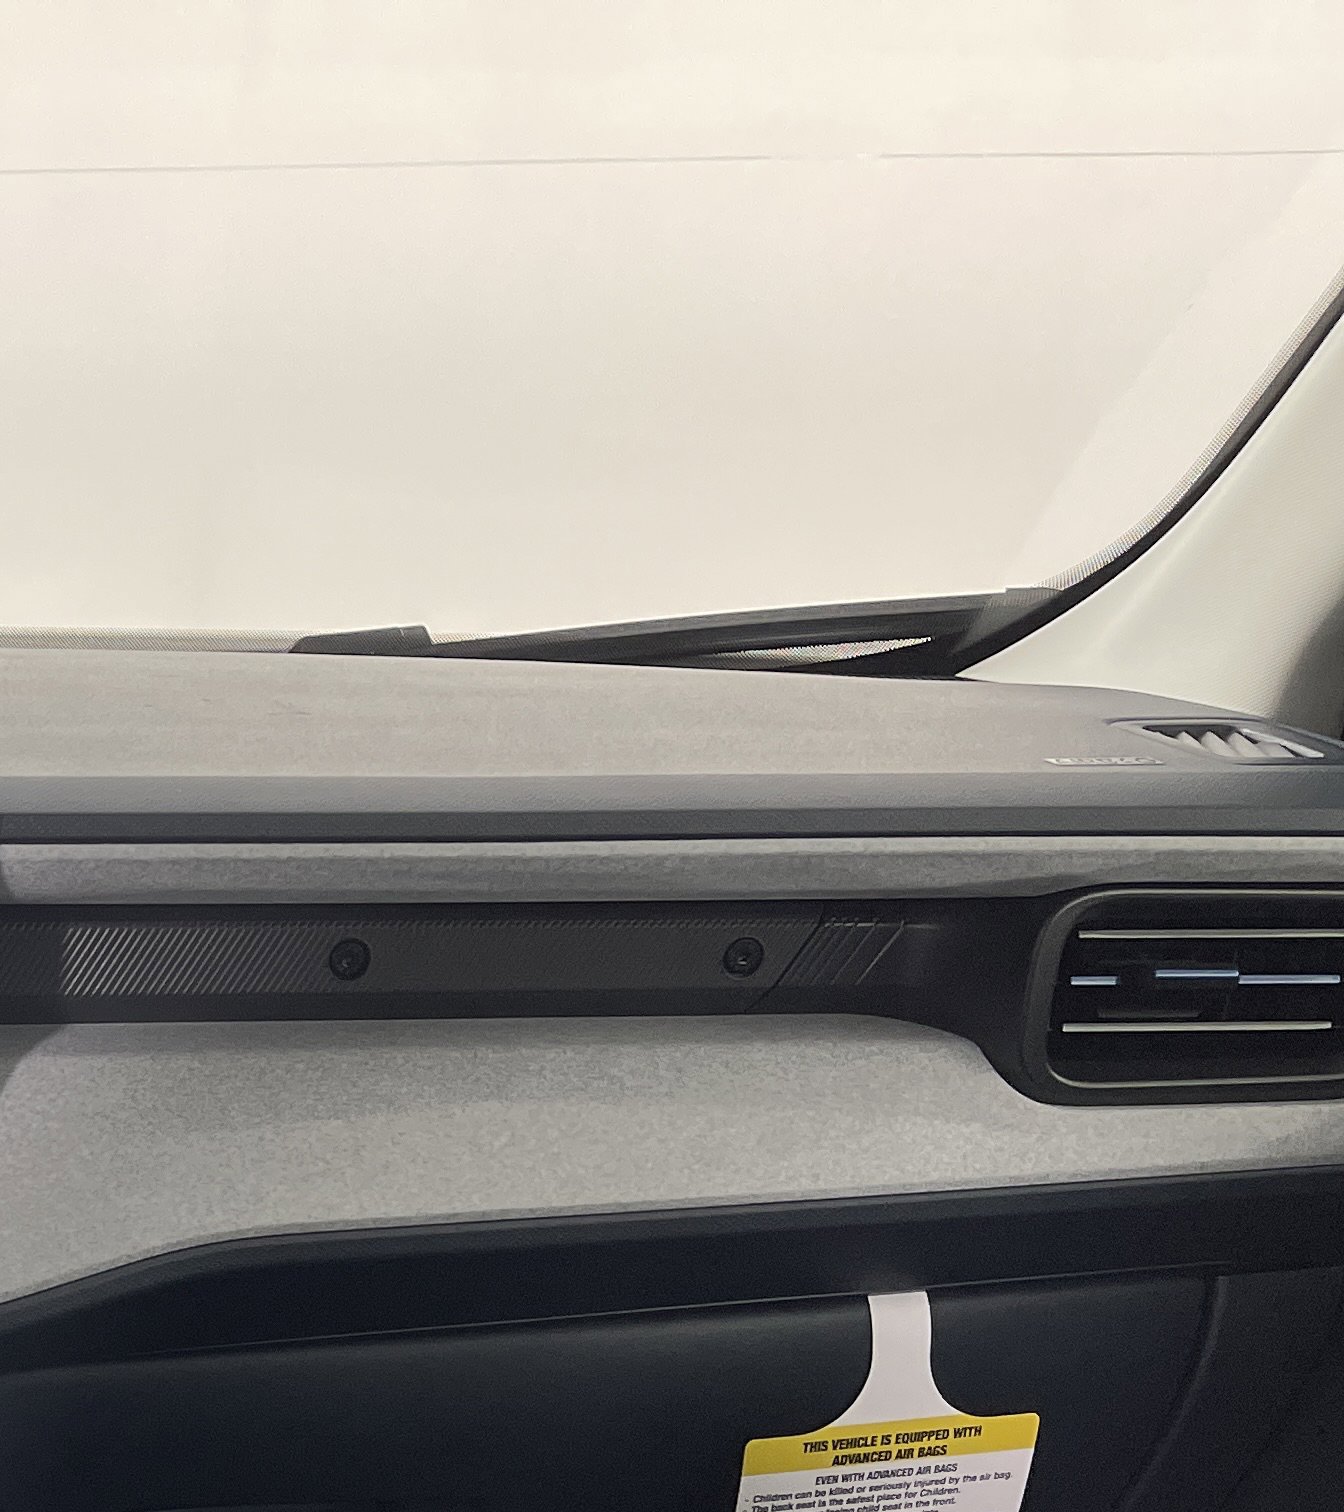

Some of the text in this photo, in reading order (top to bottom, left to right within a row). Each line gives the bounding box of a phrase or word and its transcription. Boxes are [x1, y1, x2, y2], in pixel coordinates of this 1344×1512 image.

[803, 1425, 982, 1453] THIS VEHICLE IS EQUIPPED WITH
[832, 1445, 948, 1466] ADVANCED AIR BAGS
[816, 1463, 958, 1485] EVEN WITH ADVANCED AIR BAGS
[753, 1493, 792, 1503] Children
[794, 1491, 812, 1499] can
[815, 1489, 826, 1497] be
[829, 1485, 854, 1495] killed
[869, 1482, 912, 1492] seriously
[914, 1477, 946, 1488] injured
[948, 1476, 960, 1485] by
[962, 1474, 977, 1482] the
[979, 1472, 991, 1480] air
[772, 1503, 793, 1512] back
[818, 1499, 826, 1507] is
[829, 1498, 843, 1506] the
[846, 1494, 874, 1504] safest
[876, 1492, 902, 1503] place
[904, 1490, 918, 1499] for
[857, 1504, 879, 1512] child
[882, 1502, 902, 1511] seat
[904, 1501, 913, 1509] in
[915, 1499, 930, 1507] the
